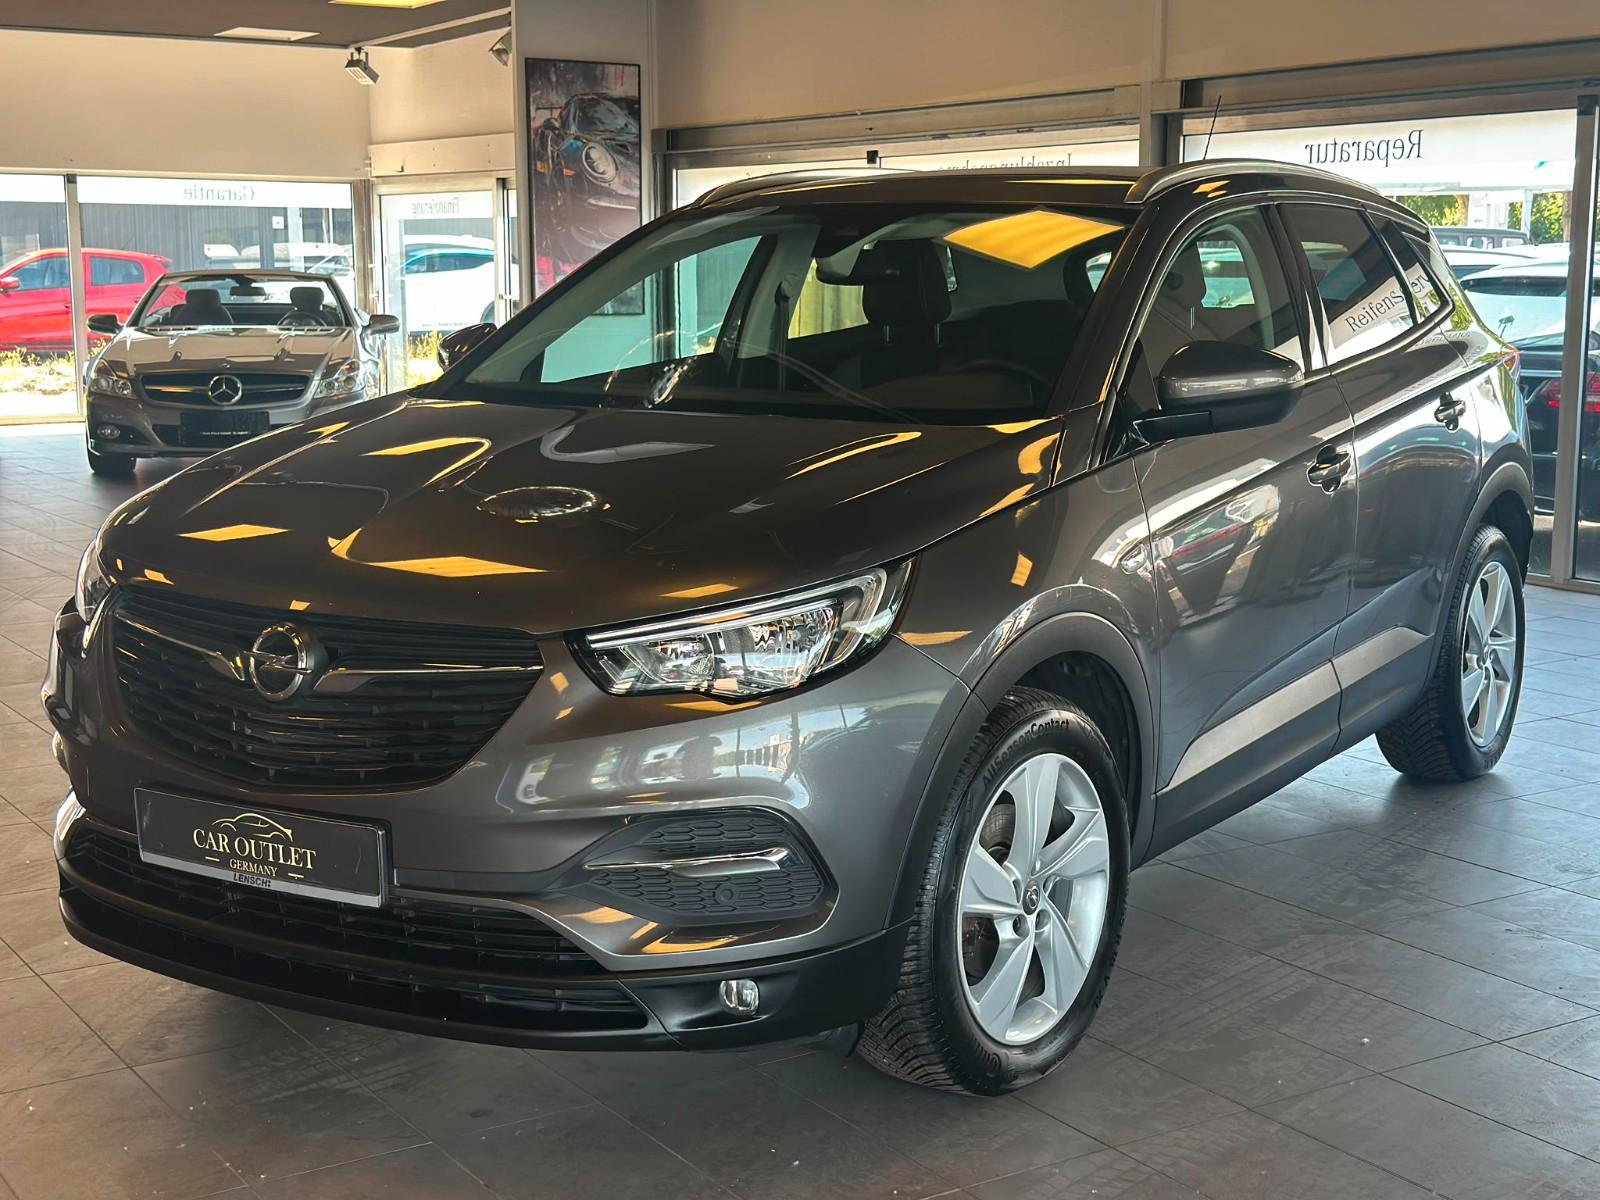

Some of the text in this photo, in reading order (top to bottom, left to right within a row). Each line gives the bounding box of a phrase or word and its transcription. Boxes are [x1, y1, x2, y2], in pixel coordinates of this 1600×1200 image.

[193, 828, 317, 869] CAR OUTLET
[229, 858, 278, 877] GERMANY
